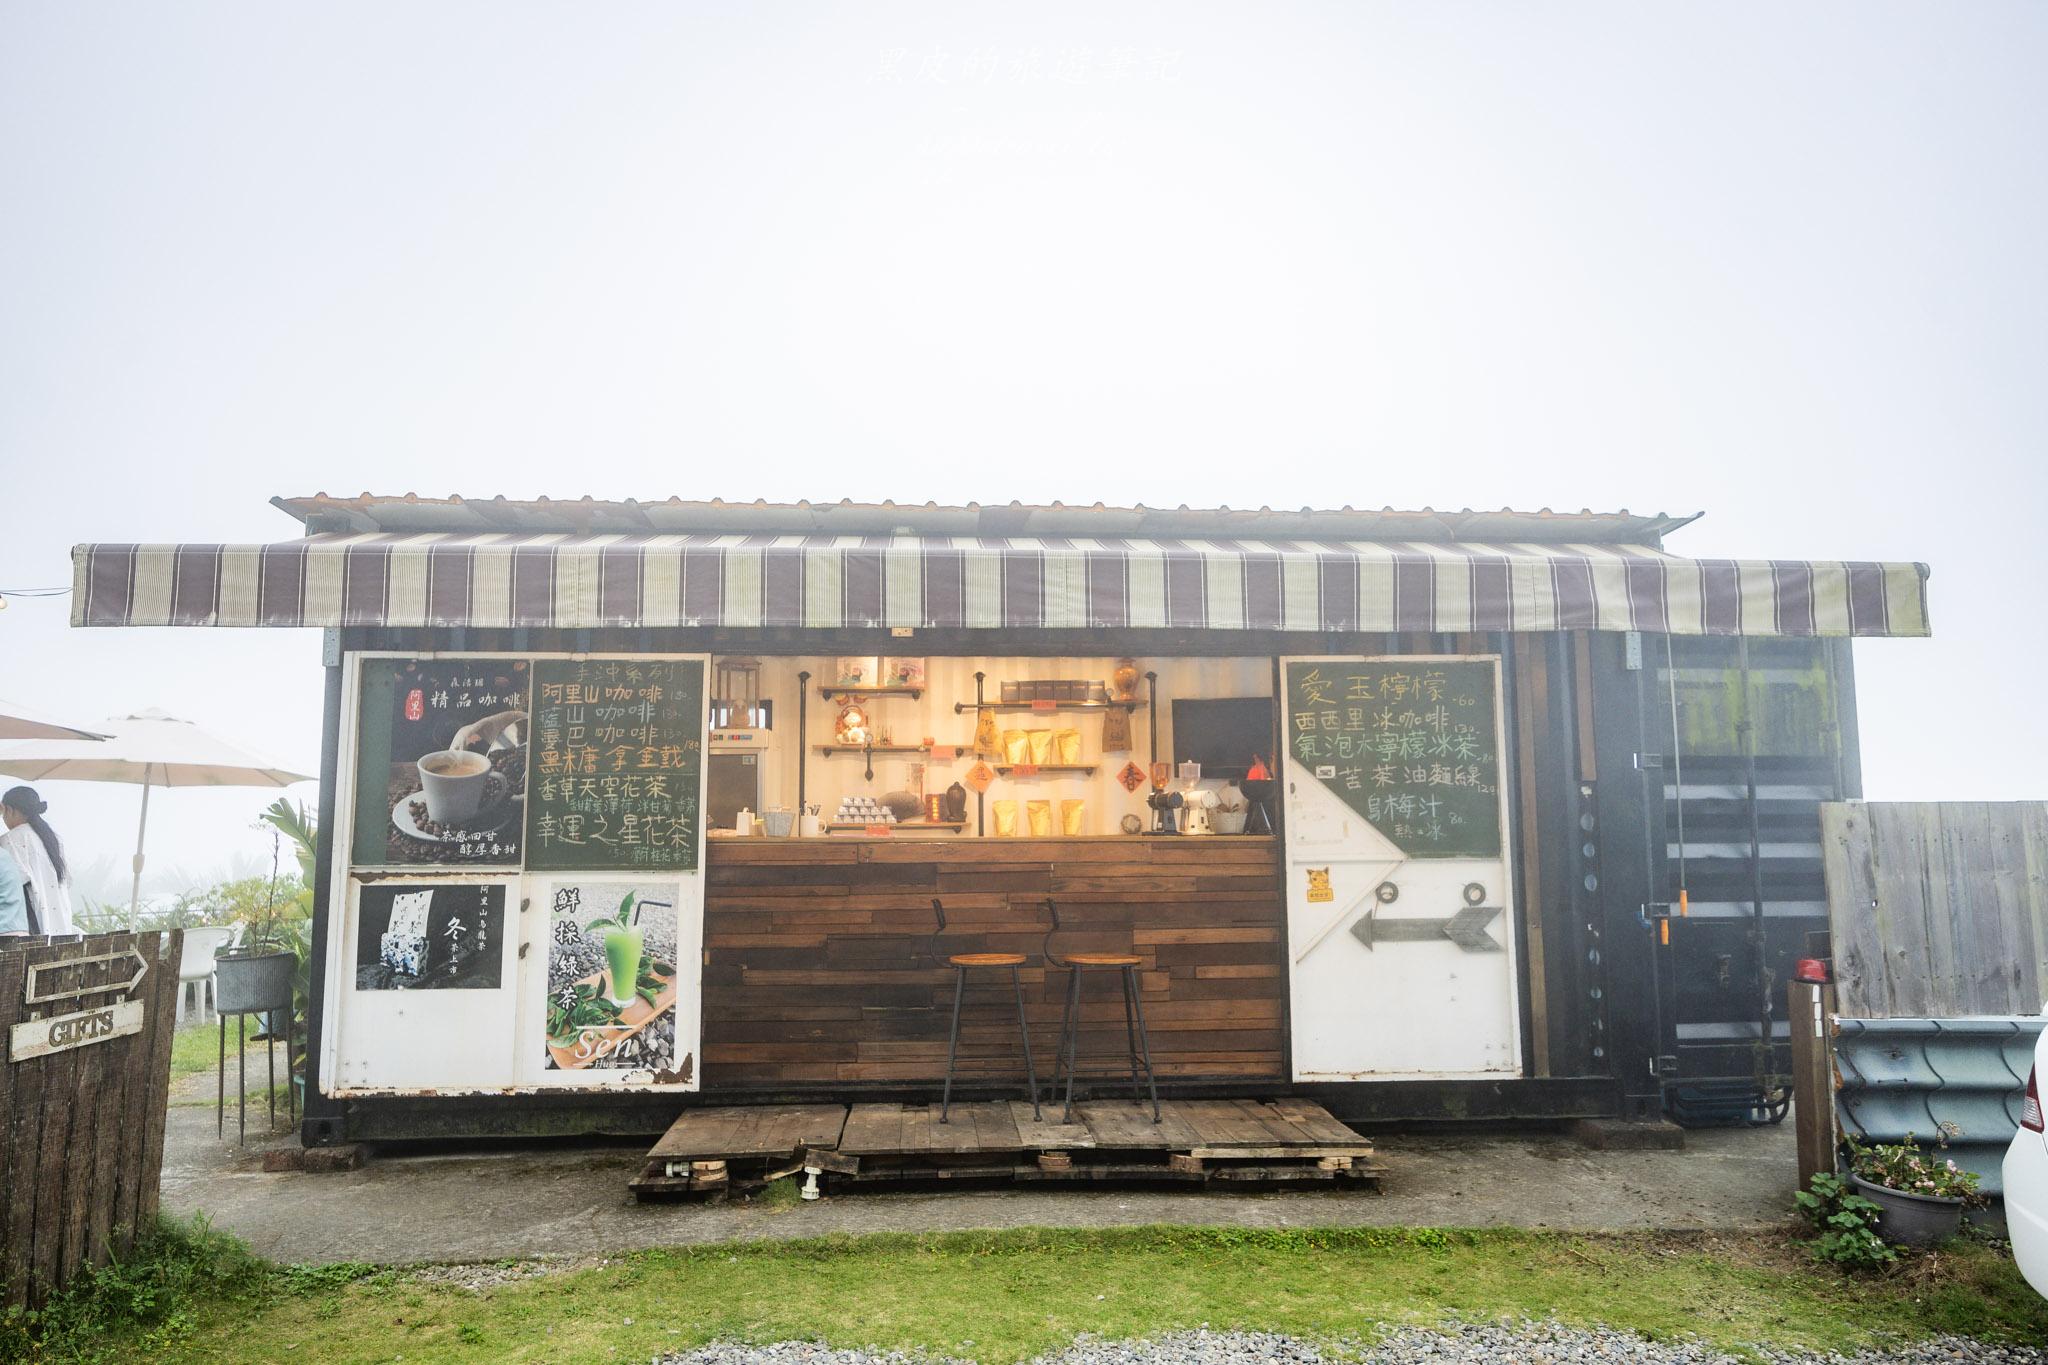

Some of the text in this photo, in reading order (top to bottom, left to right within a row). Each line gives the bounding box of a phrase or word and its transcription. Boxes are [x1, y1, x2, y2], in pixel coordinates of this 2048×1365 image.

[430, 690, 522, 709] 精品咖啡
[542, 682, 664, 704] 阿里山咖啡
[1300, 668, 1447, 706] 愛玉檸檬
[408, 689, 423, 721] 阿里山
[539, 701, 657, 728] 藍山咖啡
[1295, 706, 1451, 732] 西西里冰咖啡
[537, 776, 673, 802] 香草天空花茶
[1125, 765, 1140, 793] 春
[1368, 794, 1443, 822] 烏梅汁
[536, 811, 693, 849] 幸運之星花茶
[476, 885, 490, 951] 阿里山烏龍茶
[443, 916, 467, 975] 冬茶上市
[552, 887, 582, 1012] 鮮採綠茶
[48, 1010, 114, 1047] GIFTS
[575, 1030, 634, 1060] Sen
